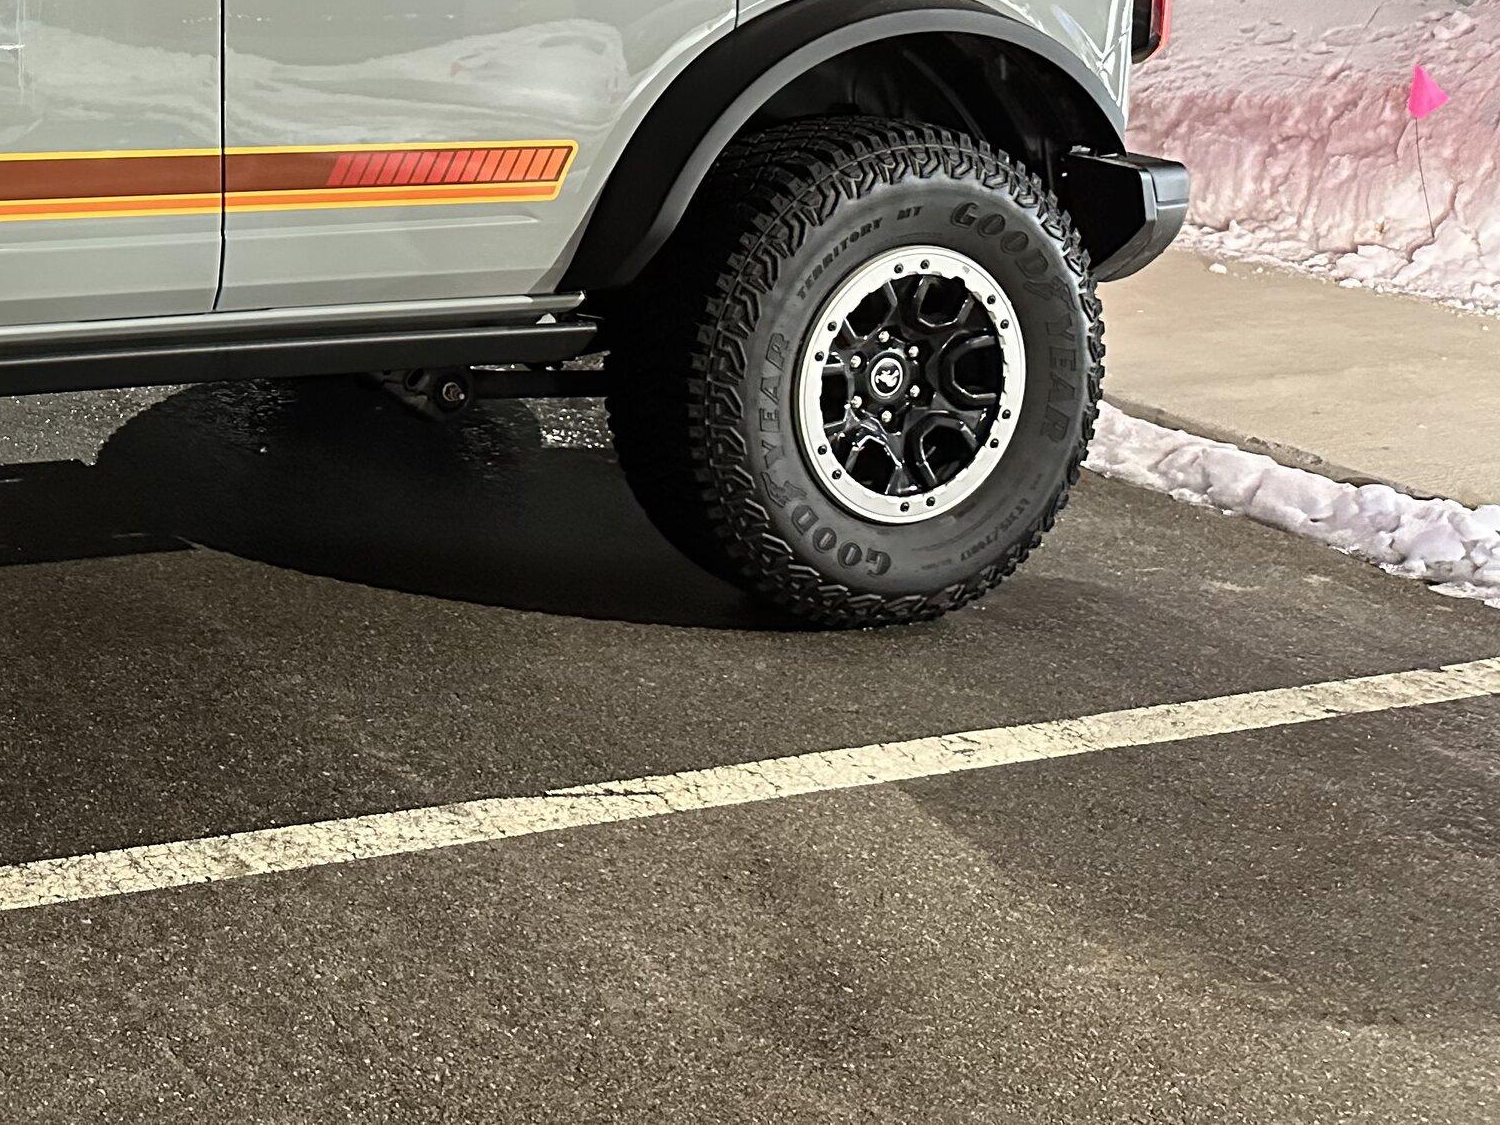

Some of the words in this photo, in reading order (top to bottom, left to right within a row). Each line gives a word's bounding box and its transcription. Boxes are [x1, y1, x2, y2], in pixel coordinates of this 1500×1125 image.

[797, 217, 883, 300] TERRITORY
[896, 205, 923, 220] MT
[950, 201, 1077, 443] GOODYEAR
[759, 331, 892, 577] GOODYEAR
